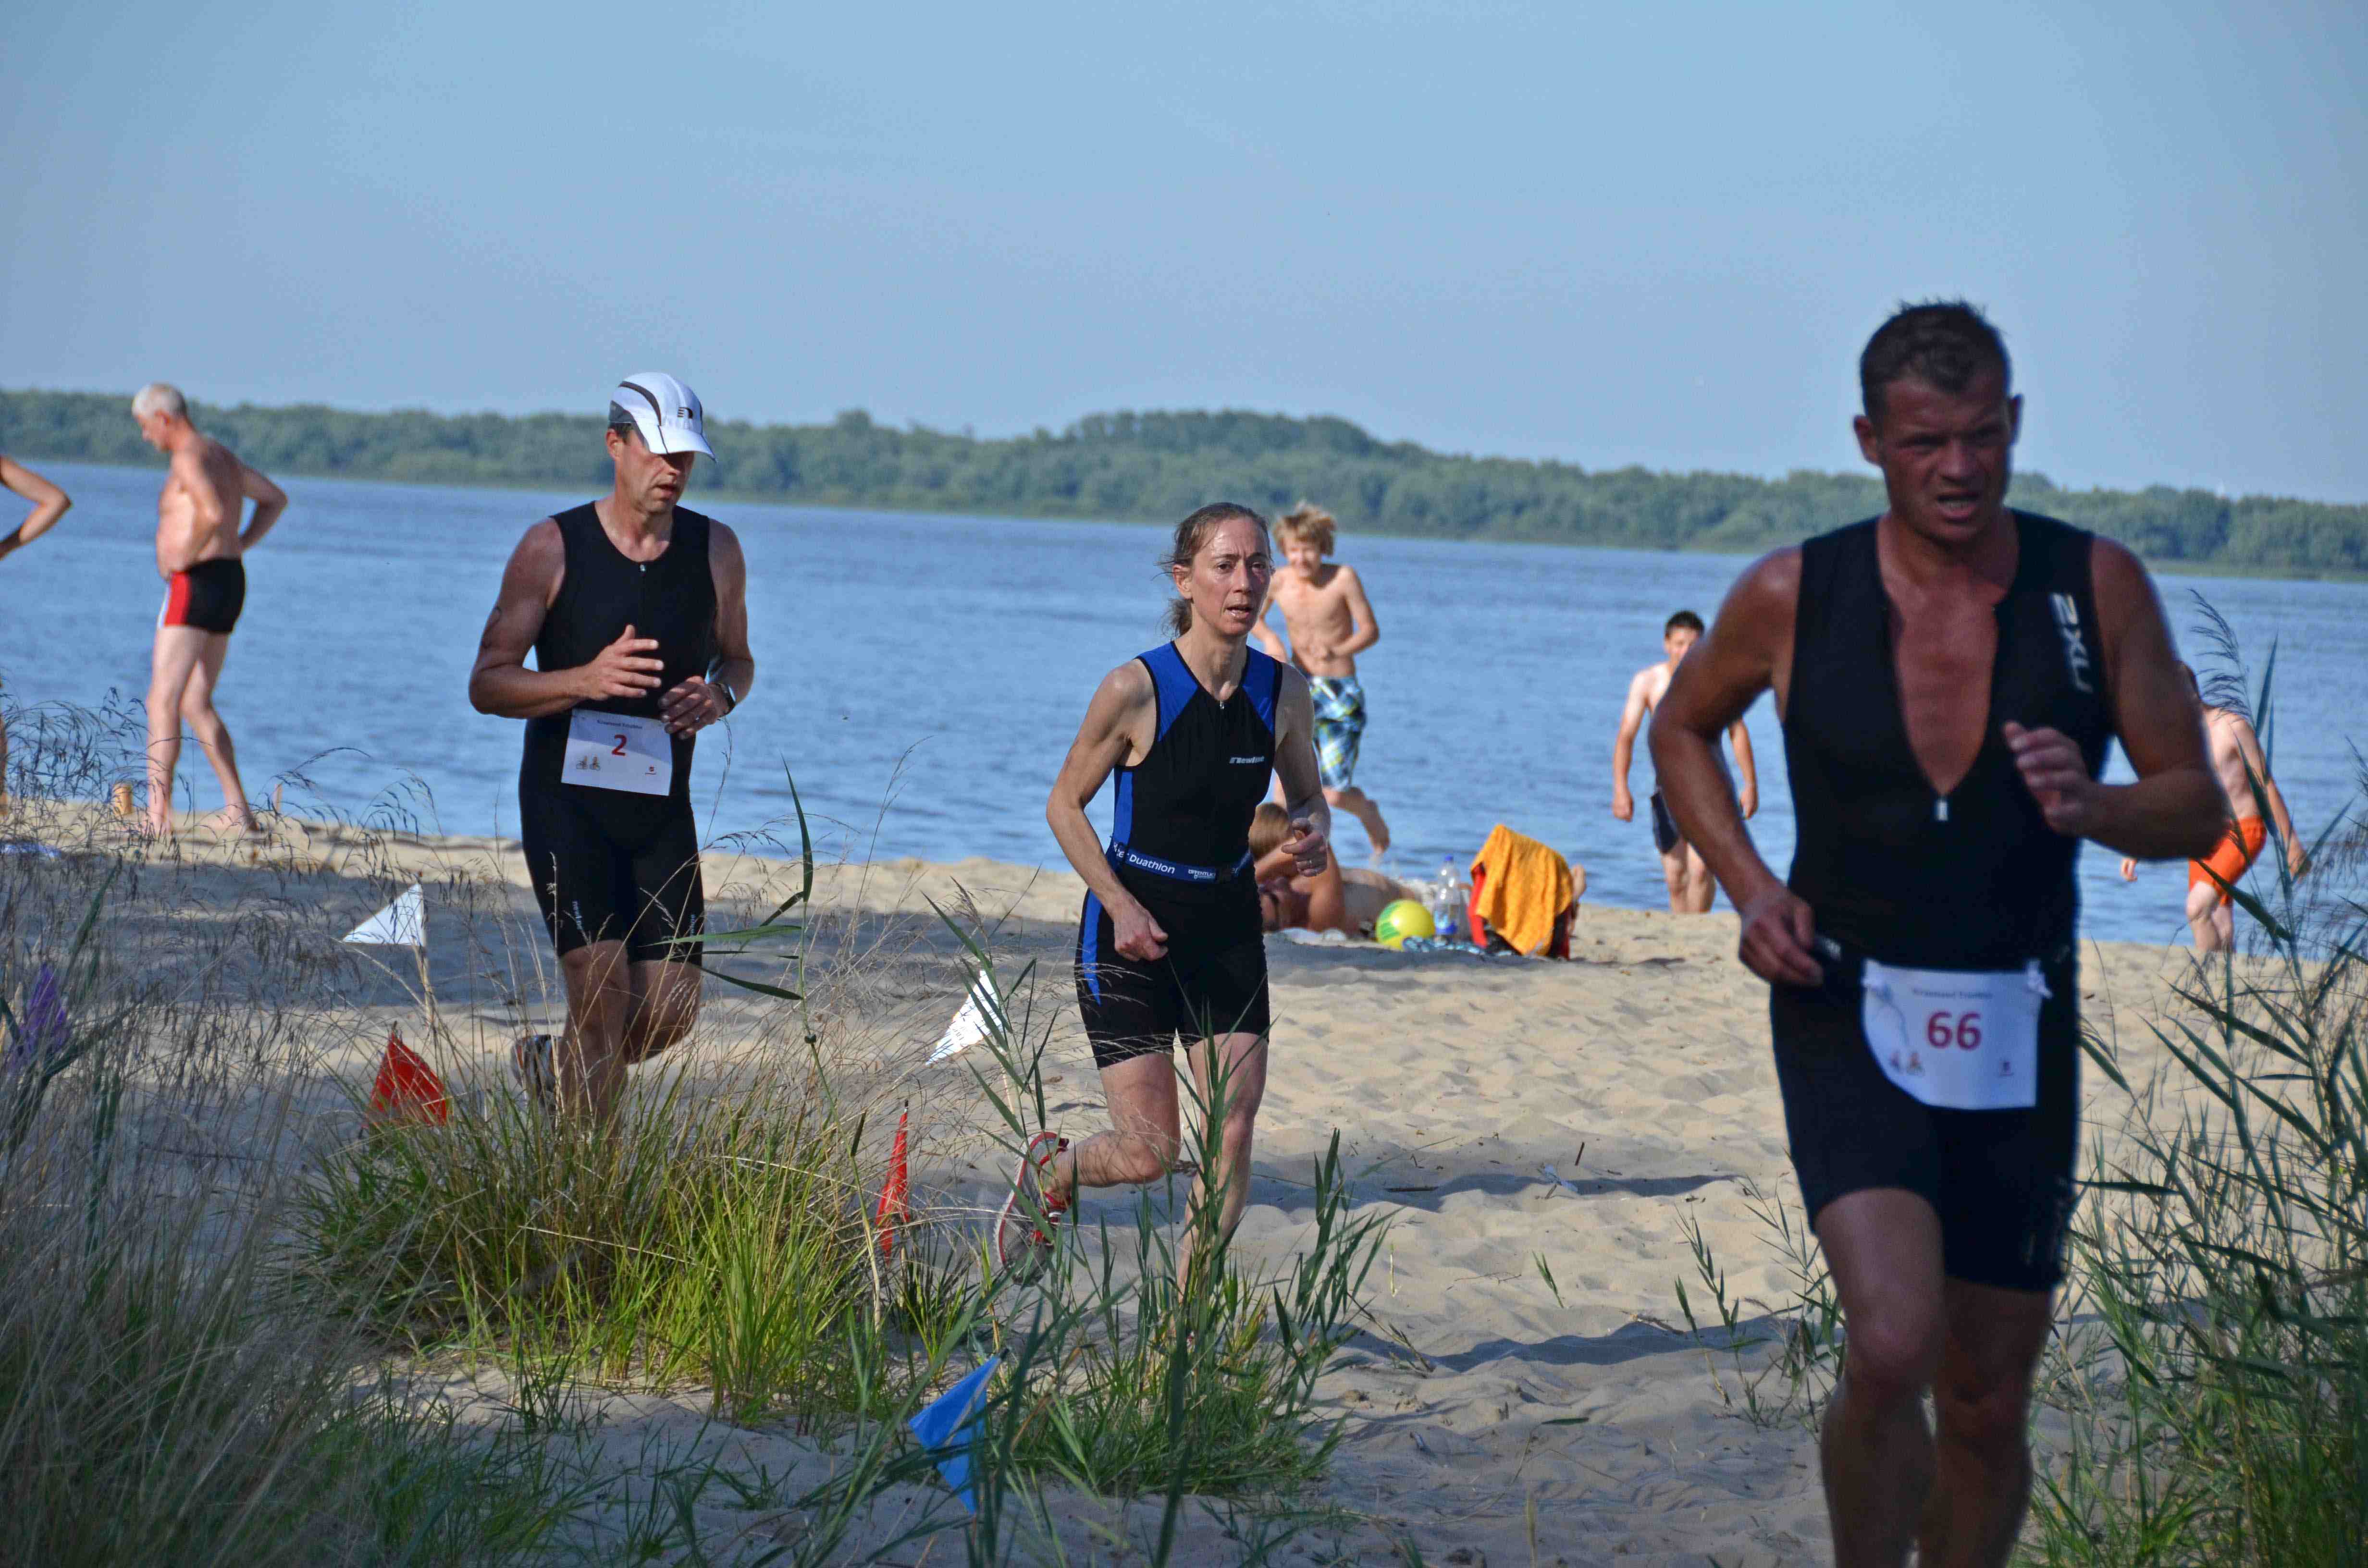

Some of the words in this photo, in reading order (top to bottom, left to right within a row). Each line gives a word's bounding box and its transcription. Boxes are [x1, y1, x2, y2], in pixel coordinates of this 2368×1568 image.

[2048, 593, 2093, 693] 2XU
[611, 734, 627, 756] 2
[1129, 854, 1175, 874] Duathlon
[1927, 1010, 1982, 1051] 66
